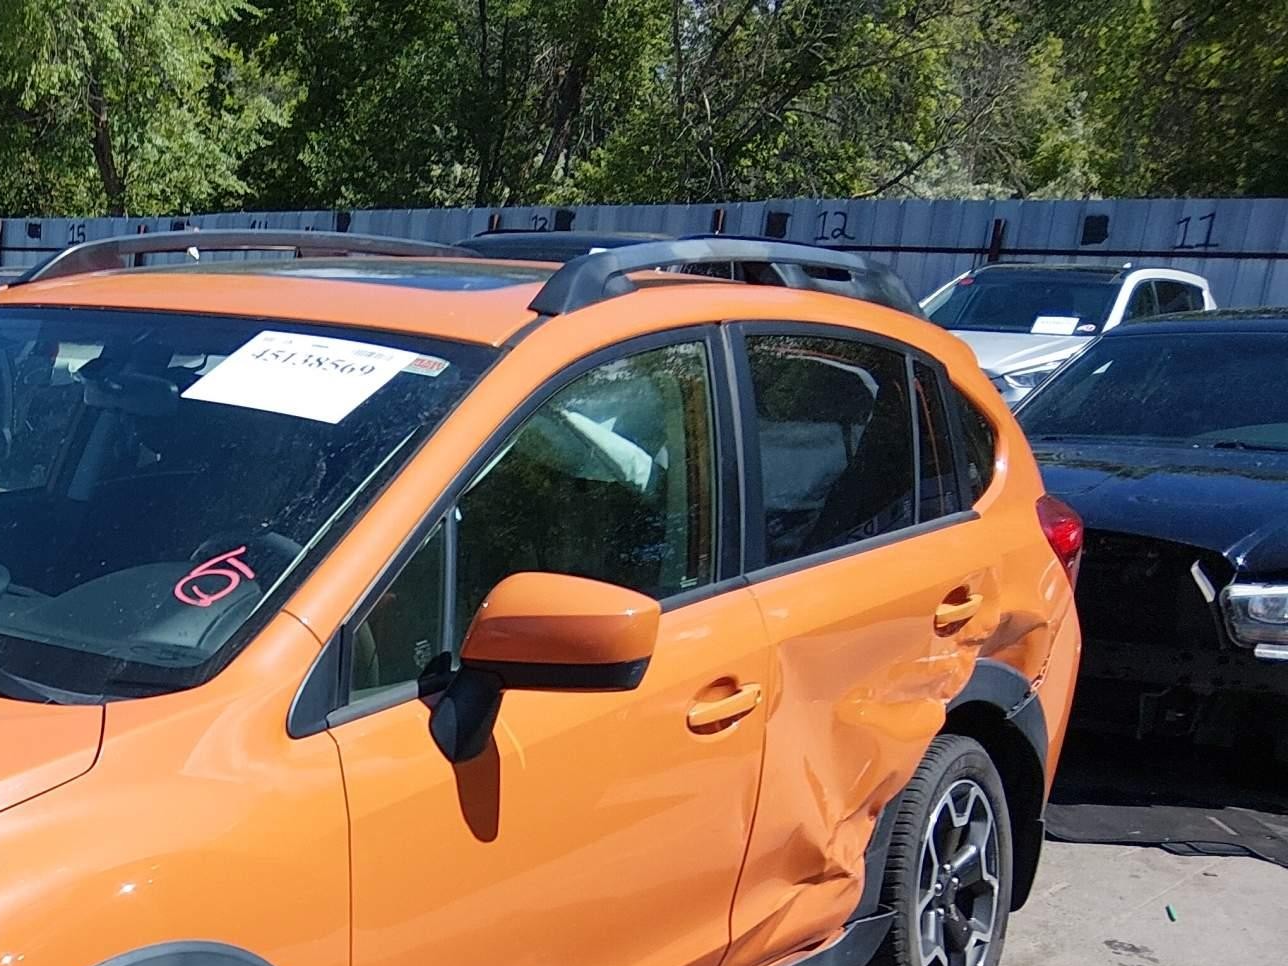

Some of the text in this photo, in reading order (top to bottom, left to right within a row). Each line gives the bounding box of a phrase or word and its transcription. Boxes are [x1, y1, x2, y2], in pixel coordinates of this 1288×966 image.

[67, 223, 87, 246] 15
[814, 211, 856, 242] 12
[1174, 212, 1220, 250] 11
[251, 348, 376, 377] 45138569
